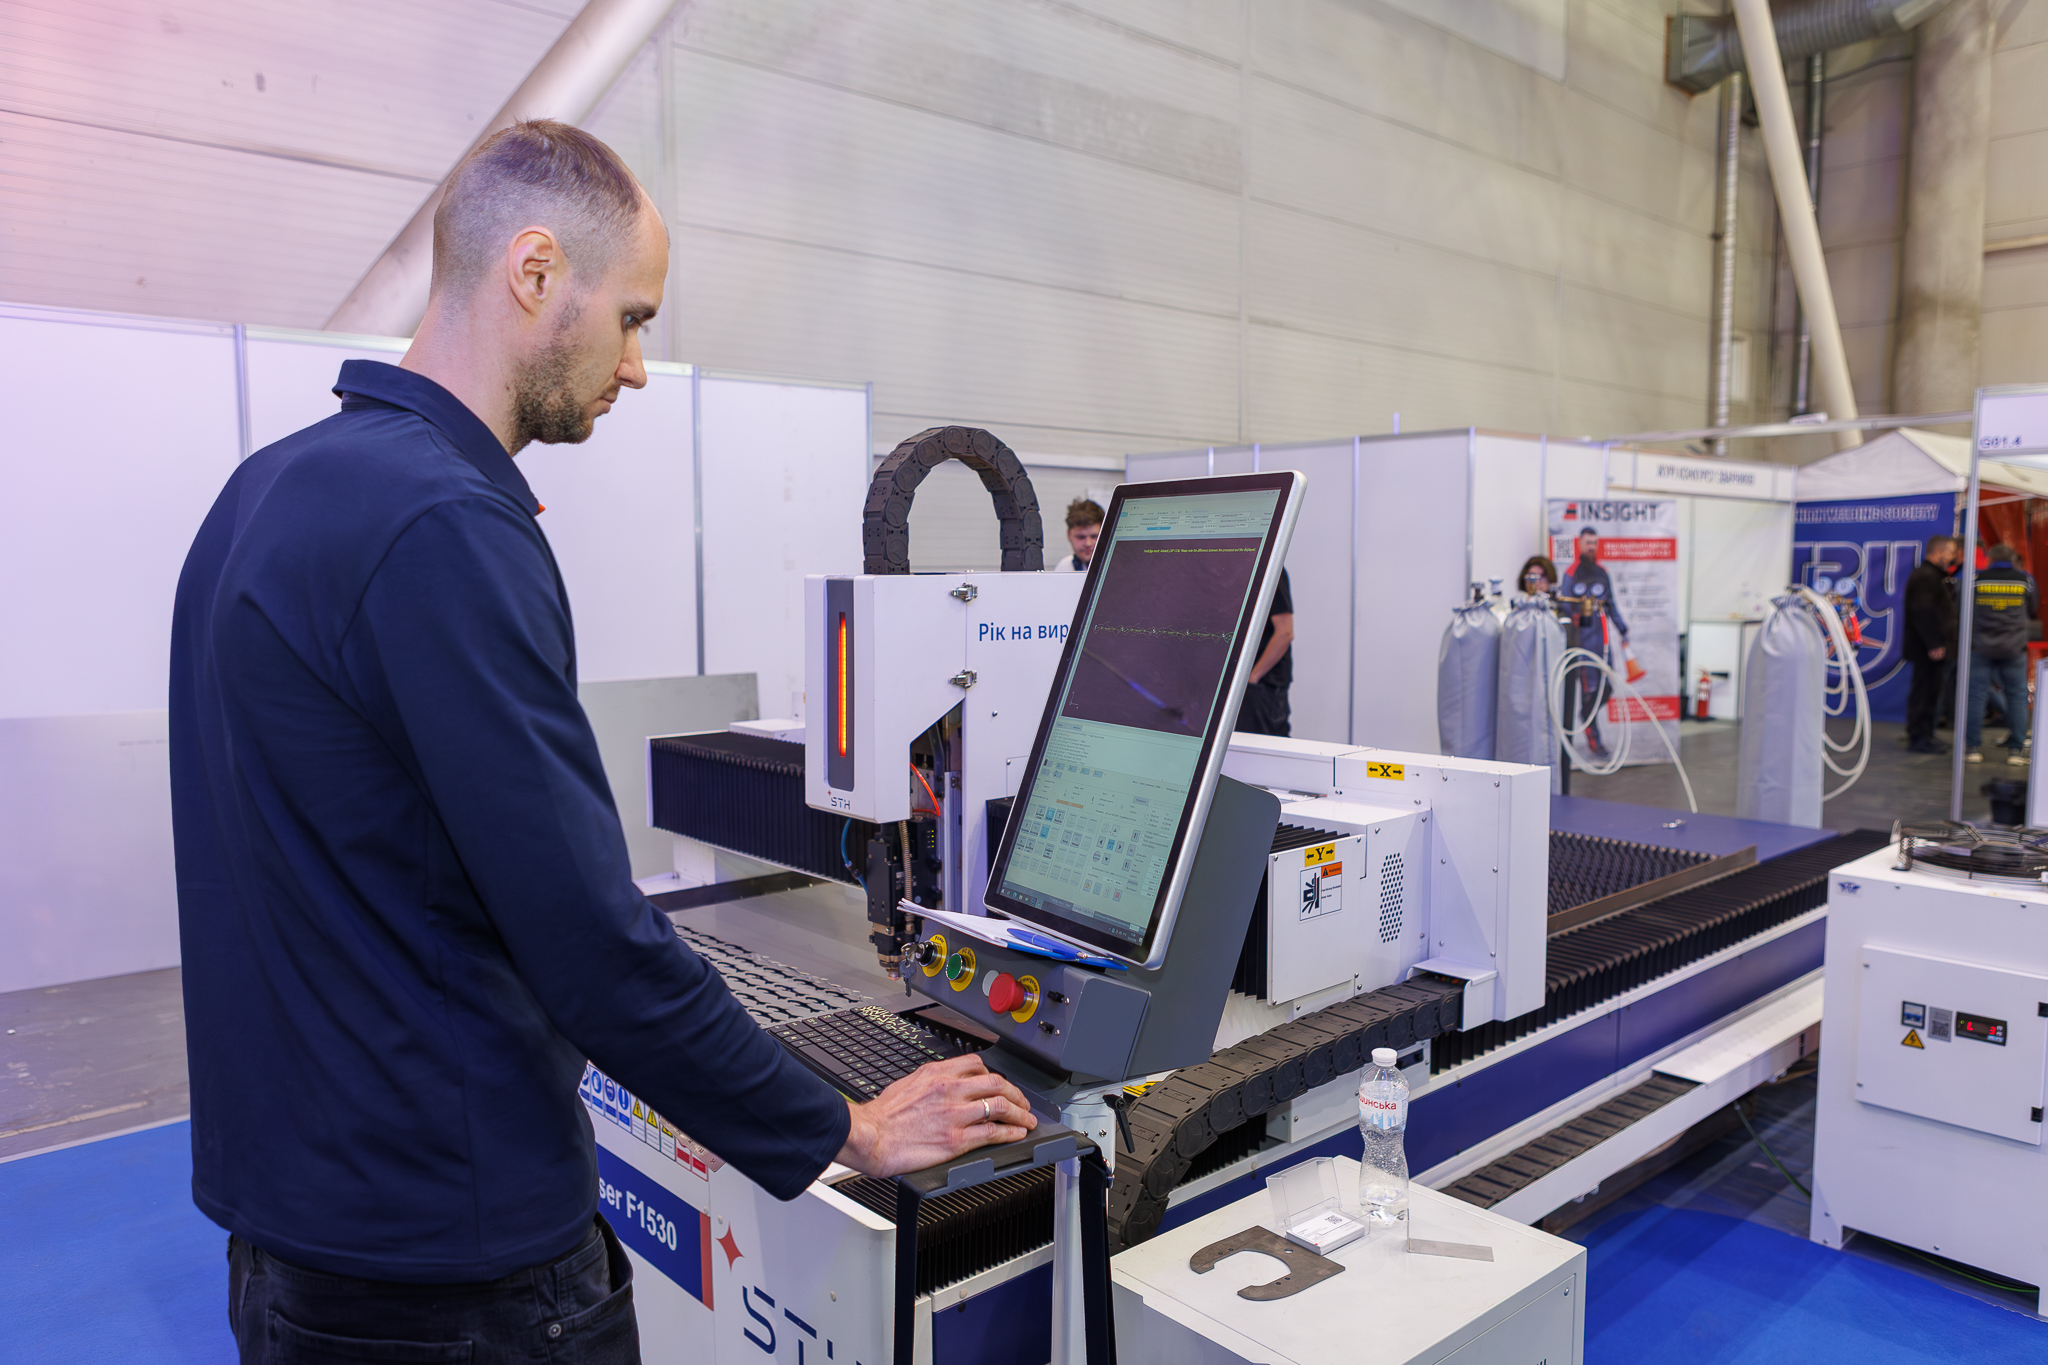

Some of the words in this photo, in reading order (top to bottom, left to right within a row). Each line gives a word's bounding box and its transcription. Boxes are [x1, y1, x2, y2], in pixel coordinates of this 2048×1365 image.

[1580, 502, 1659, 521] INSIGHT
[979, 622, 1006, 642] Рік
[1011, 625, 1032, 640] на
[1038, 624, 1069, 643] вир
[1379, 764, 1392, 778] X
[830, 796, 851, 810] STH
[1315, 846, 1326, 861] Y
[1359, 1093, 1397, 1110] шинська
[599, 1177, 622, 1210] ser
[626, 1190, 677, 1252] F1530
[742, 1286, 863, 1365] ST
